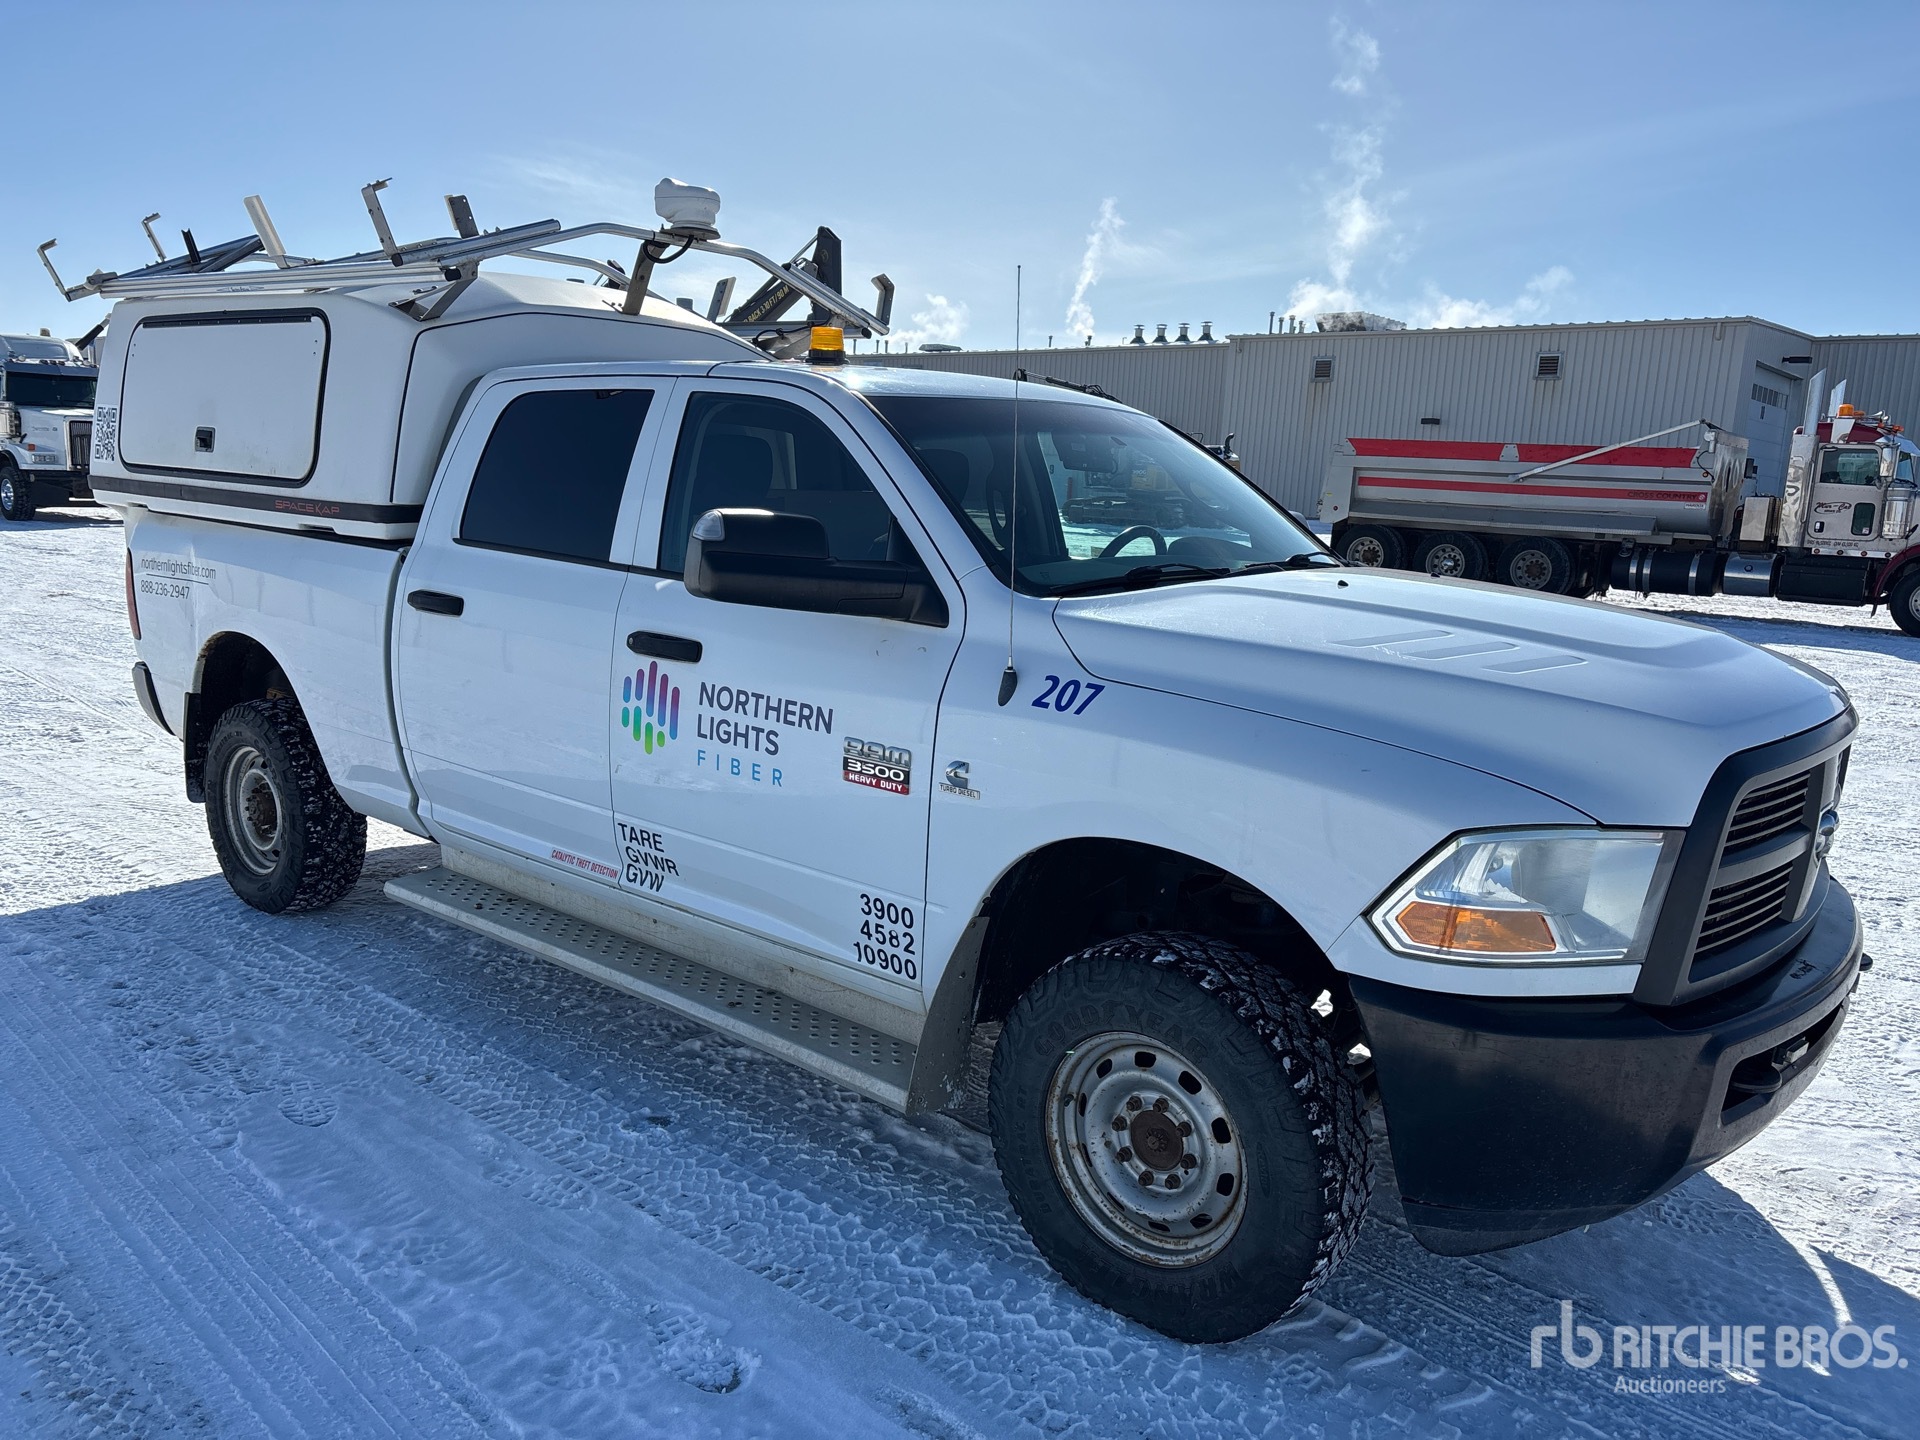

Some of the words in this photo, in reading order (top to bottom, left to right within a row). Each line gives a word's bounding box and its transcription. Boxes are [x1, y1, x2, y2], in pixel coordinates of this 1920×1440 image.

[275, 500, 340, 516] SPACEKAP
[1627, 491, 1655, 499] CROSS
[1656, 493, 1698, 501] COUNTRY
[140, 579, 190, 600] 888-236-2947
[698, 681, 834, 735] NORTHERN
[1031, 674, 1106, 716] 207
[697, 713, 780, 756] LIGHTS
[697, 749, 783, 788] FIBER
[847, 758, 905, 782] 3500
[849, 772, 877, 787] HEAVY
[880, 780, 902, 792] DUTY
[940, 784, 957, 794] TURBO
[957, 788, 976, 798] DIESEL
[617, 822, 665, 853] TARE
[551, 849, 576, 865] CATALYTIC
[575, 857, 592, 869] THEFT
[590, 862, 619, 879] DETECTION
[625, 845, 680, 877] GVWR
[626, 863, 665, 893] GVW
[860, 893, 914, 929] 3900
[860, 919, 916, 956] 4582
[853, 941, 917, 980] 10900
